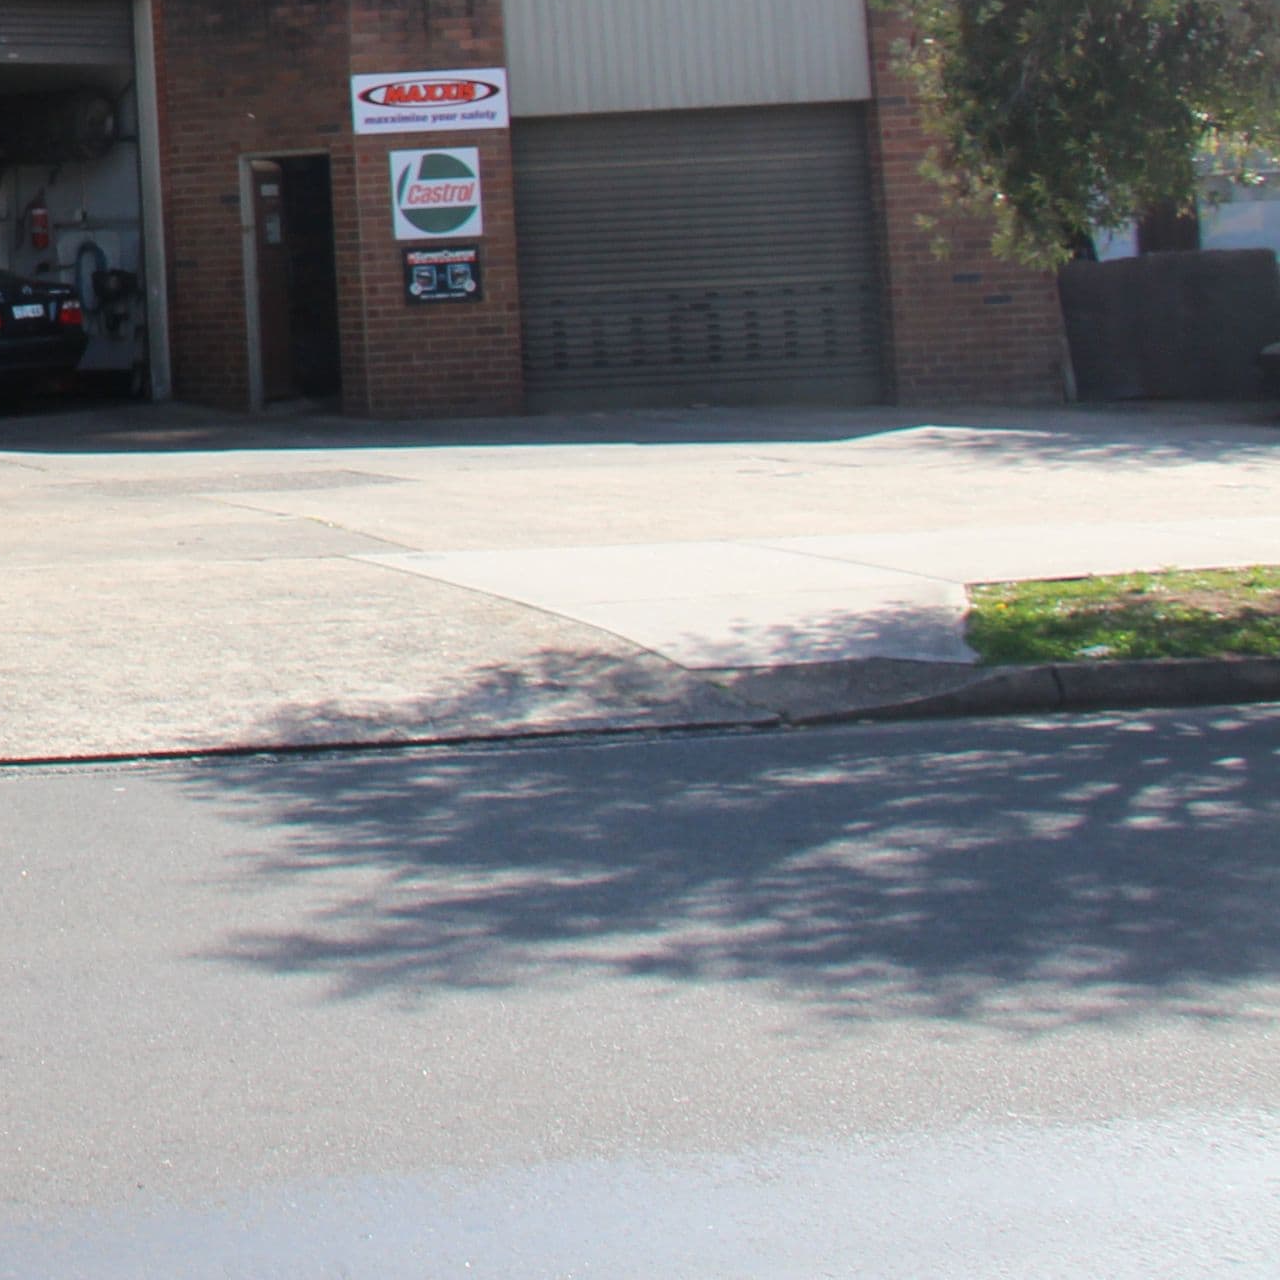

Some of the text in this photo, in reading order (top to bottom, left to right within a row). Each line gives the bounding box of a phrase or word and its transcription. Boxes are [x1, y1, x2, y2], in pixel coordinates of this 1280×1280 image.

[383, 81, 476, 105] MAXXIS
[431, 111, 457, 123] your
[461, 109, 497, 121] safety
[408, 182, 475, 205] Castrol
